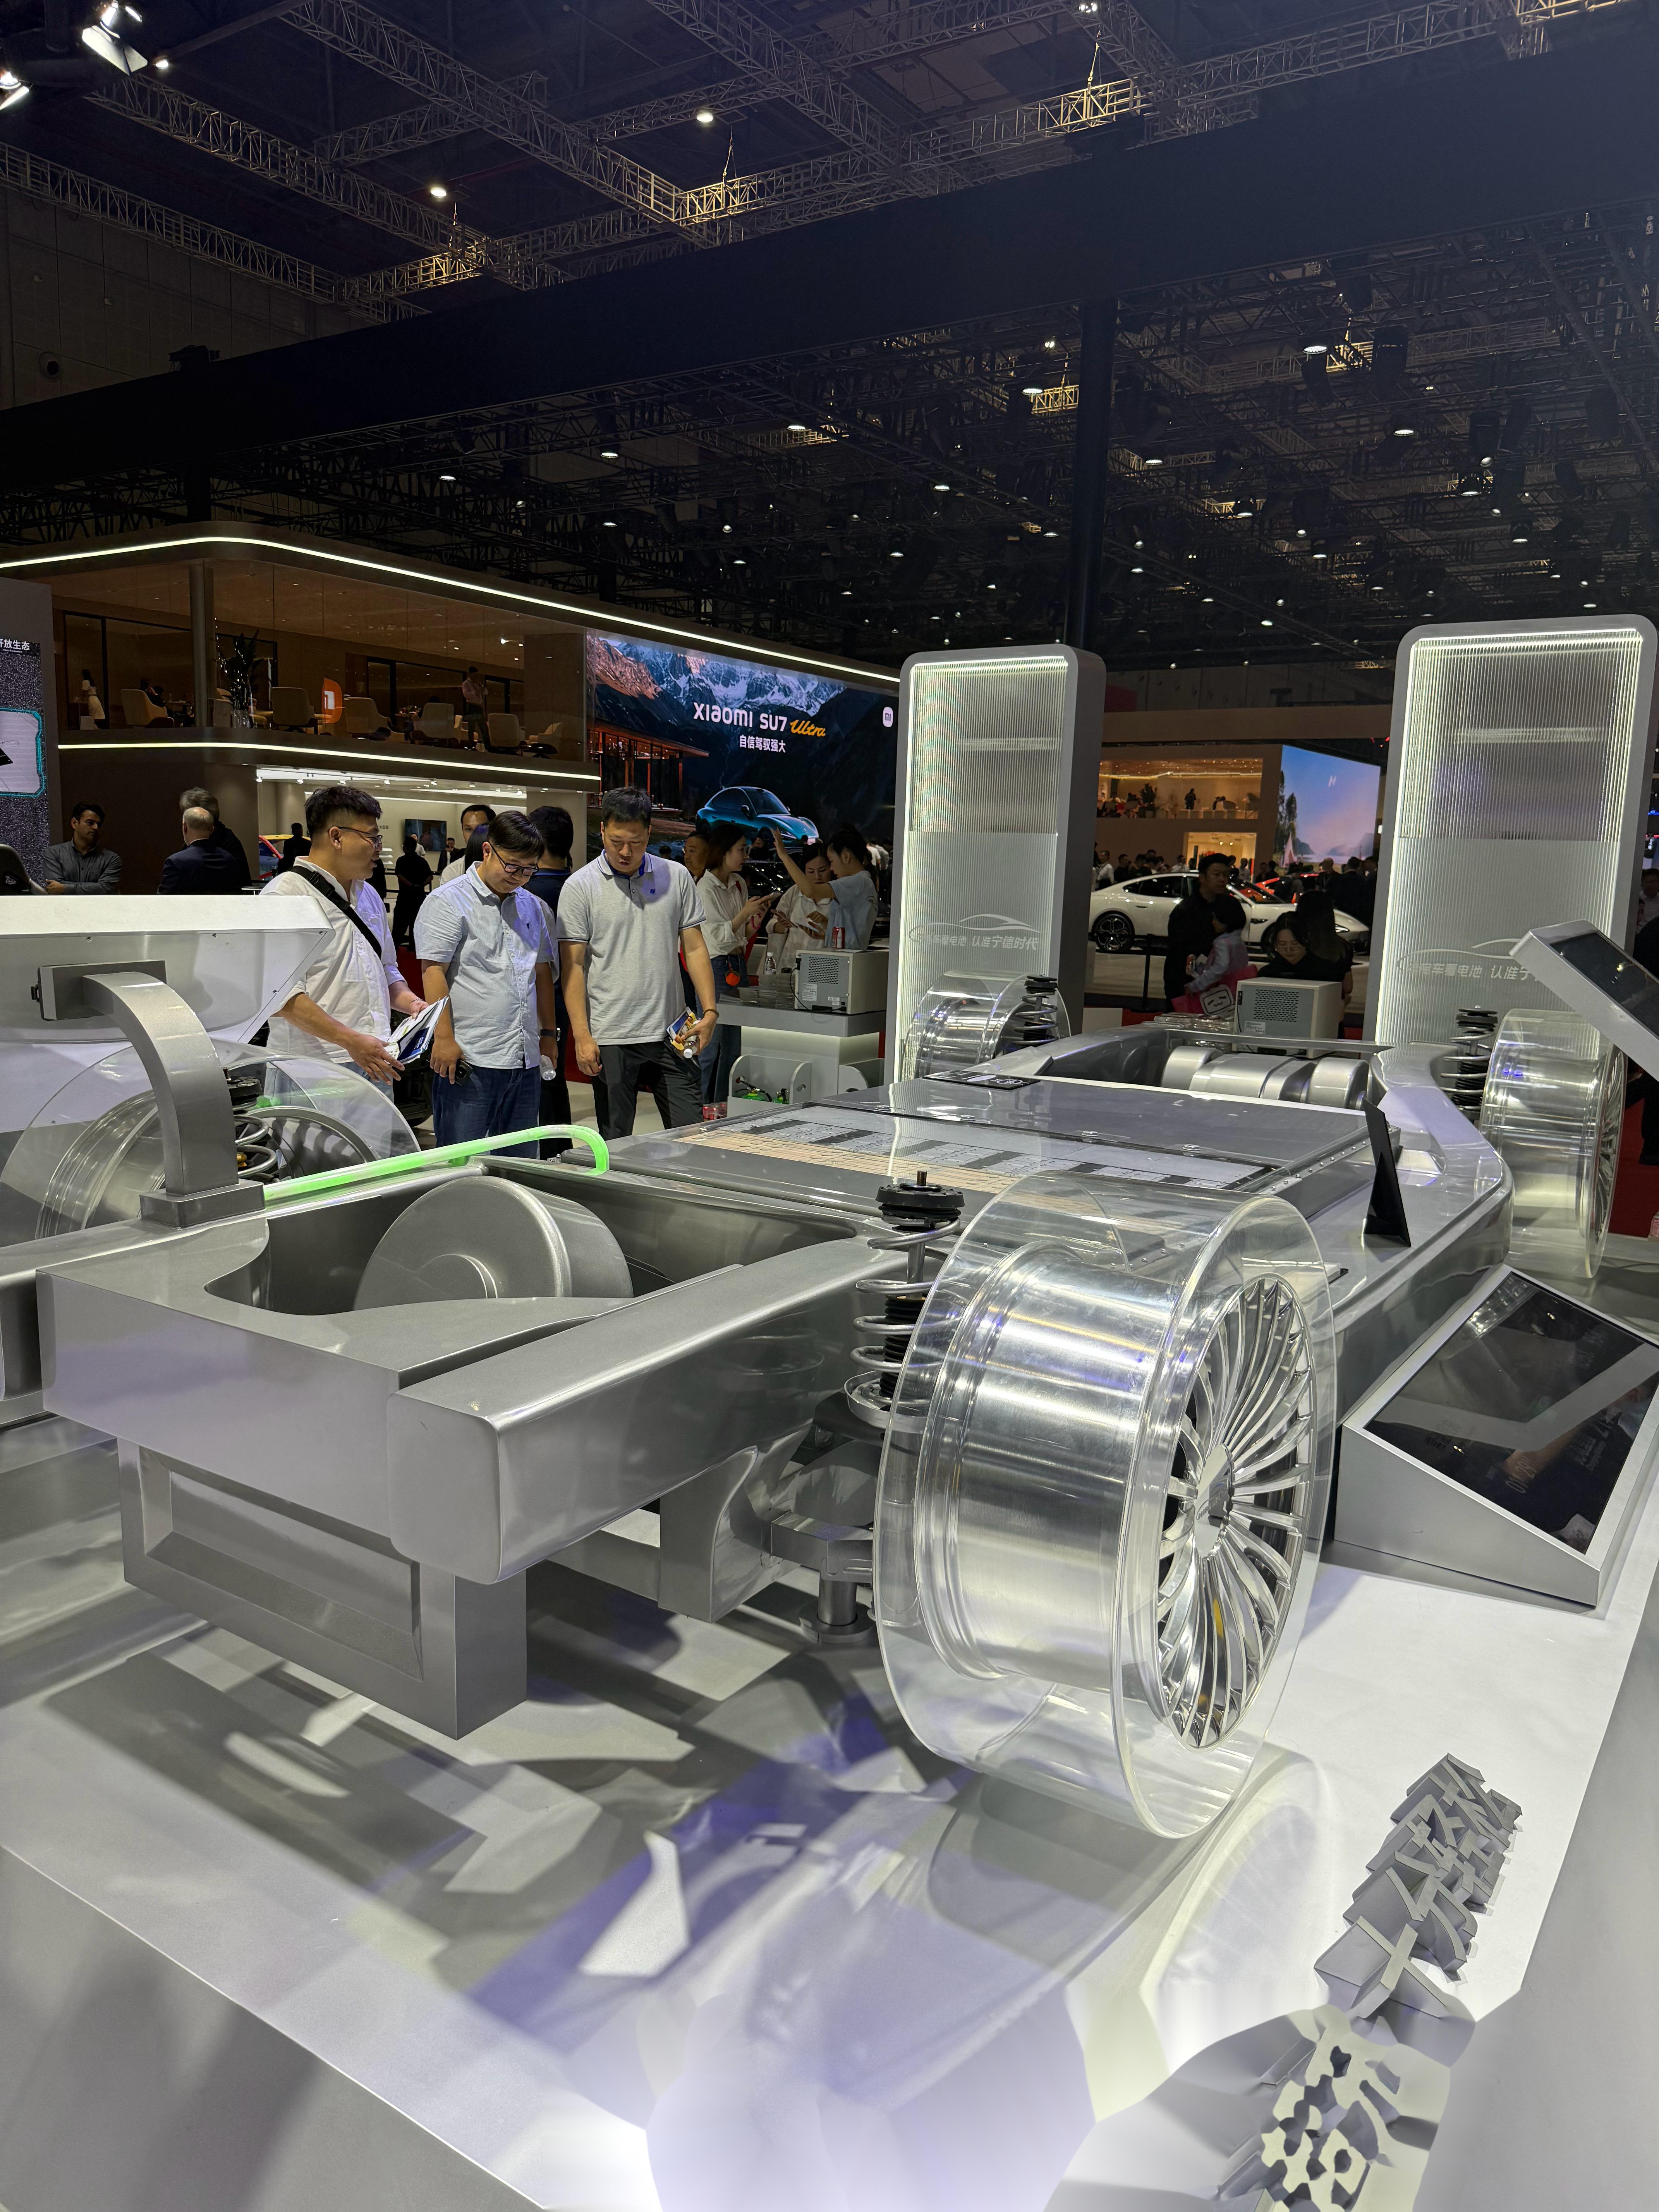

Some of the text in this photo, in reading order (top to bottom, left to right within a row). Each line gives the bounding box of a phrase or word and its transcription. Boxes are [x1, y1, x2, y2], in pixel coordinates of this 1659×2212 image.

[760, 713, 787, 732] SU7
[790, 720, 826, 737] Ultra
[739, 734, 786, 753] 自信驾驭强大
[972, 935, 1039, 950] 认准宁德时代
[1491, 965, 1539, 982] 认准宁
